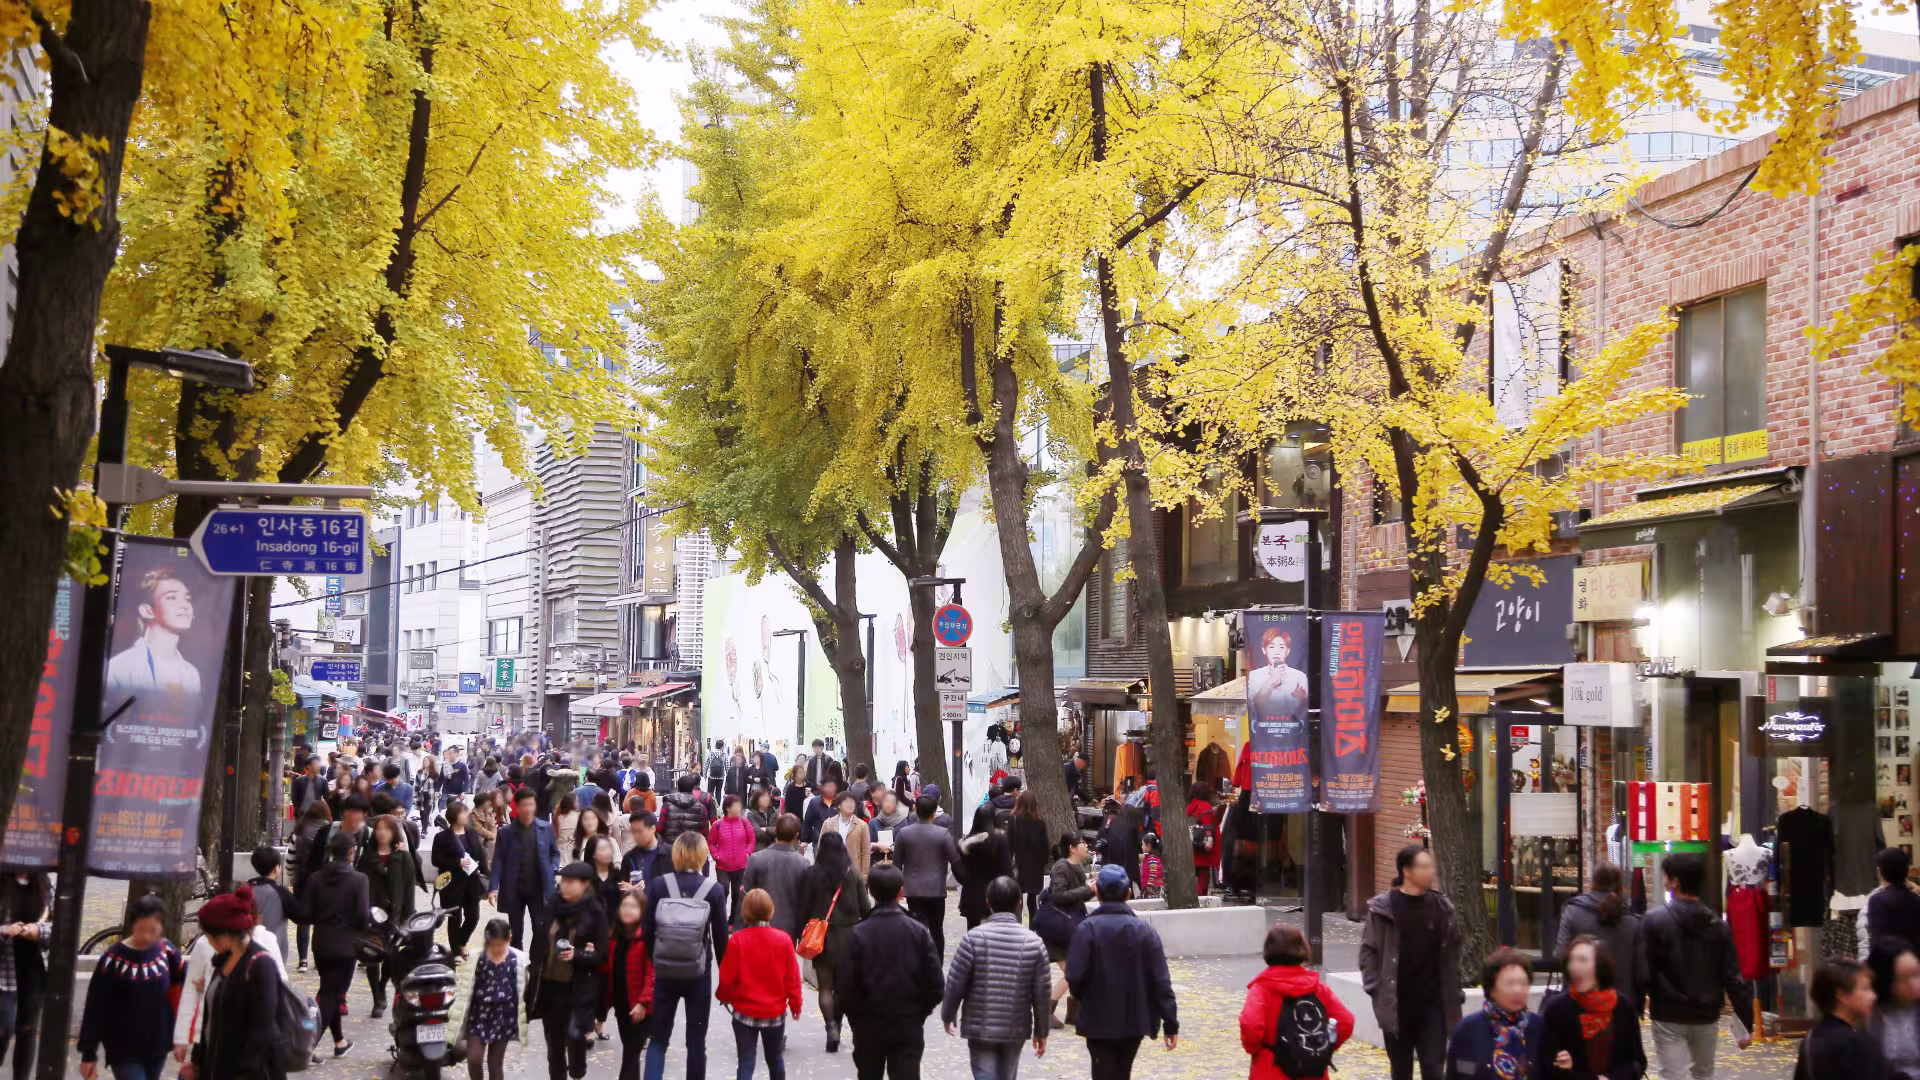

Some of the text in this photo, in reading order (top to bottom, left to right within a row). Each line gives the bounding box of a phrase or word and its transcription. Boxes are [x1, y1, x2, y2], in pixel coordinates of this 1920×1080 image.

[213, 523, 228, 534] 26
[256, 540, 359, 556] Insadong 16-gil
[1261, 535, 1290, 550] 본죽
[1495, 595, 1540, 633] 고양이
[938, 652, 968, 661] 견인지역
[1329, 623, 1343, 677] IN THE HEIGHTS
[1332, 621, 1368, 758] 인더하이츠
[1570, 686, 1603, 703] 10k gold
[943, 694, 964, 702] 구간내
